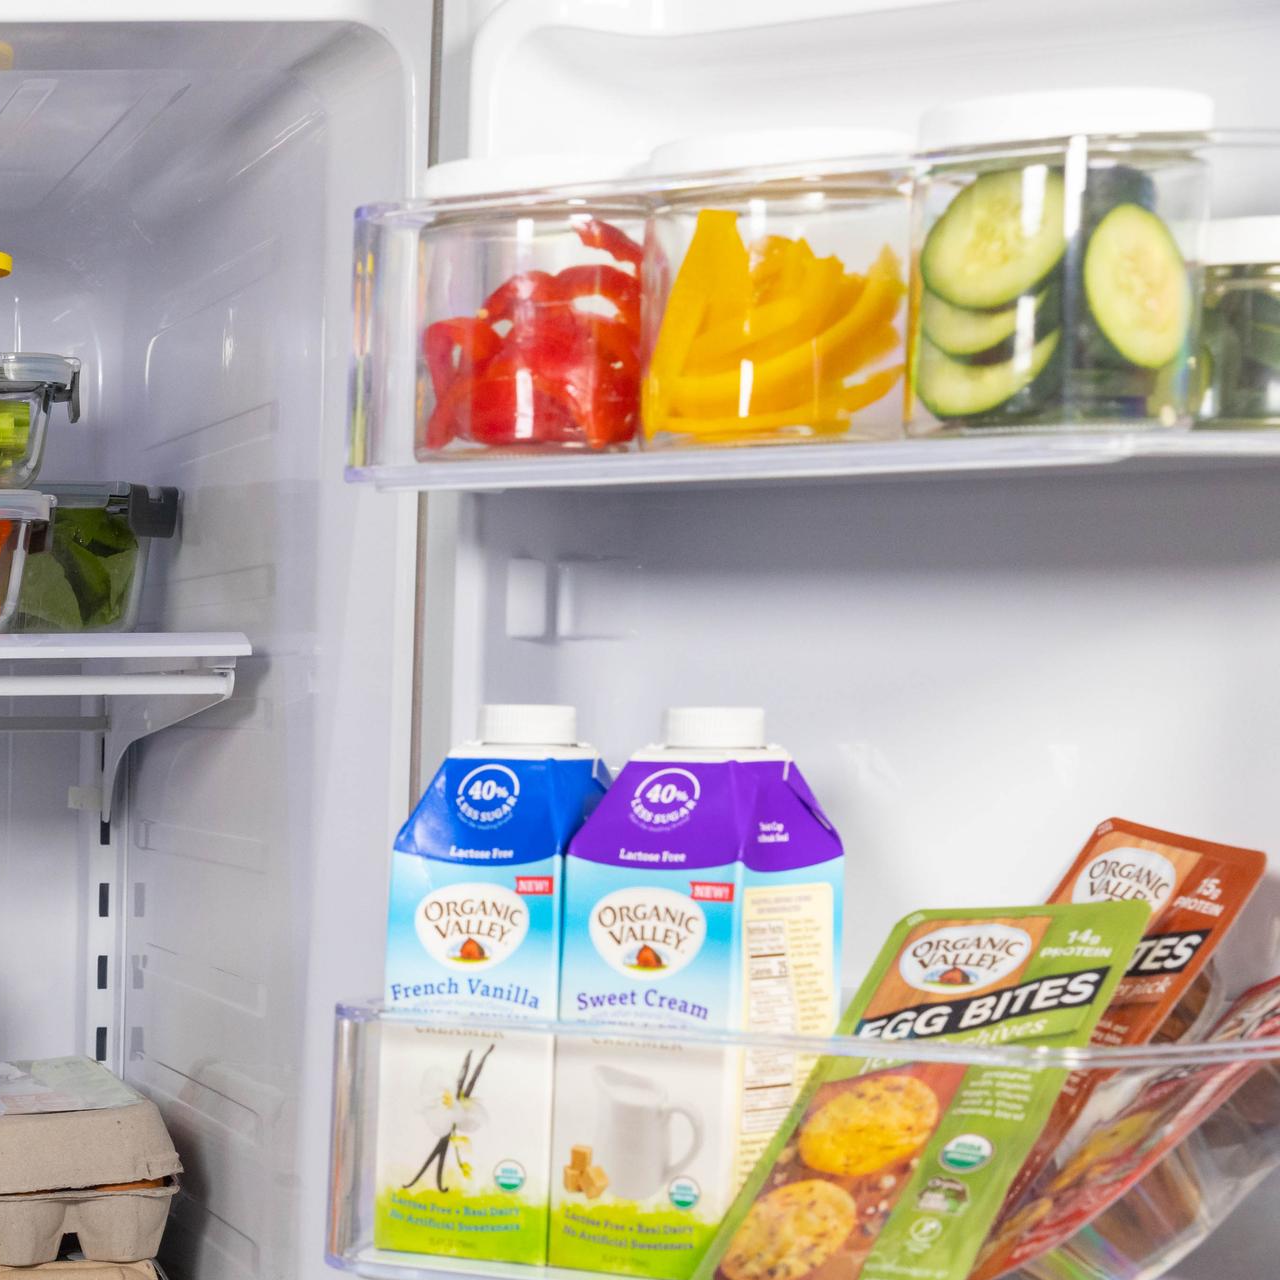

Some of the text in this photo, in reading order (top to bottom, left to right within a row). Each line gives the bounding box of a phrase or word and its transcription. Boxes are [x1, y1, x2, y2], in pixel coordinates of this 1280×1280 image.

[468, 780, 508, 801] 40%
[646, 784, 688, 804] 40%
[518, 879, 550, 892] NEW!
[1089, 859, 1170, 899] ORGANIC
[694, 885, 730, 899] NEW!
[425, 899, 524, 927] ORGANIC
[1173, 897, 1224, 917] PROTEIN
[597, 904, 700, 934] ORGANIC
[434, 920, 512, 942] VALLEY
[608, 925, 688, 951] VALLEY
[1067, 930, 1101, 945] 14g
[912, 937, 1024, 959] ORGANIC
[1040, 945, 1112, 958] PROTEIN
[918, 951, 1004, 971] VALLEY
[391, 978, 540, 1009] French Vanilla
[577, 989, 708, 1020] Sweet Cream
[857, 972, 1101, 1040] EGG BITES
